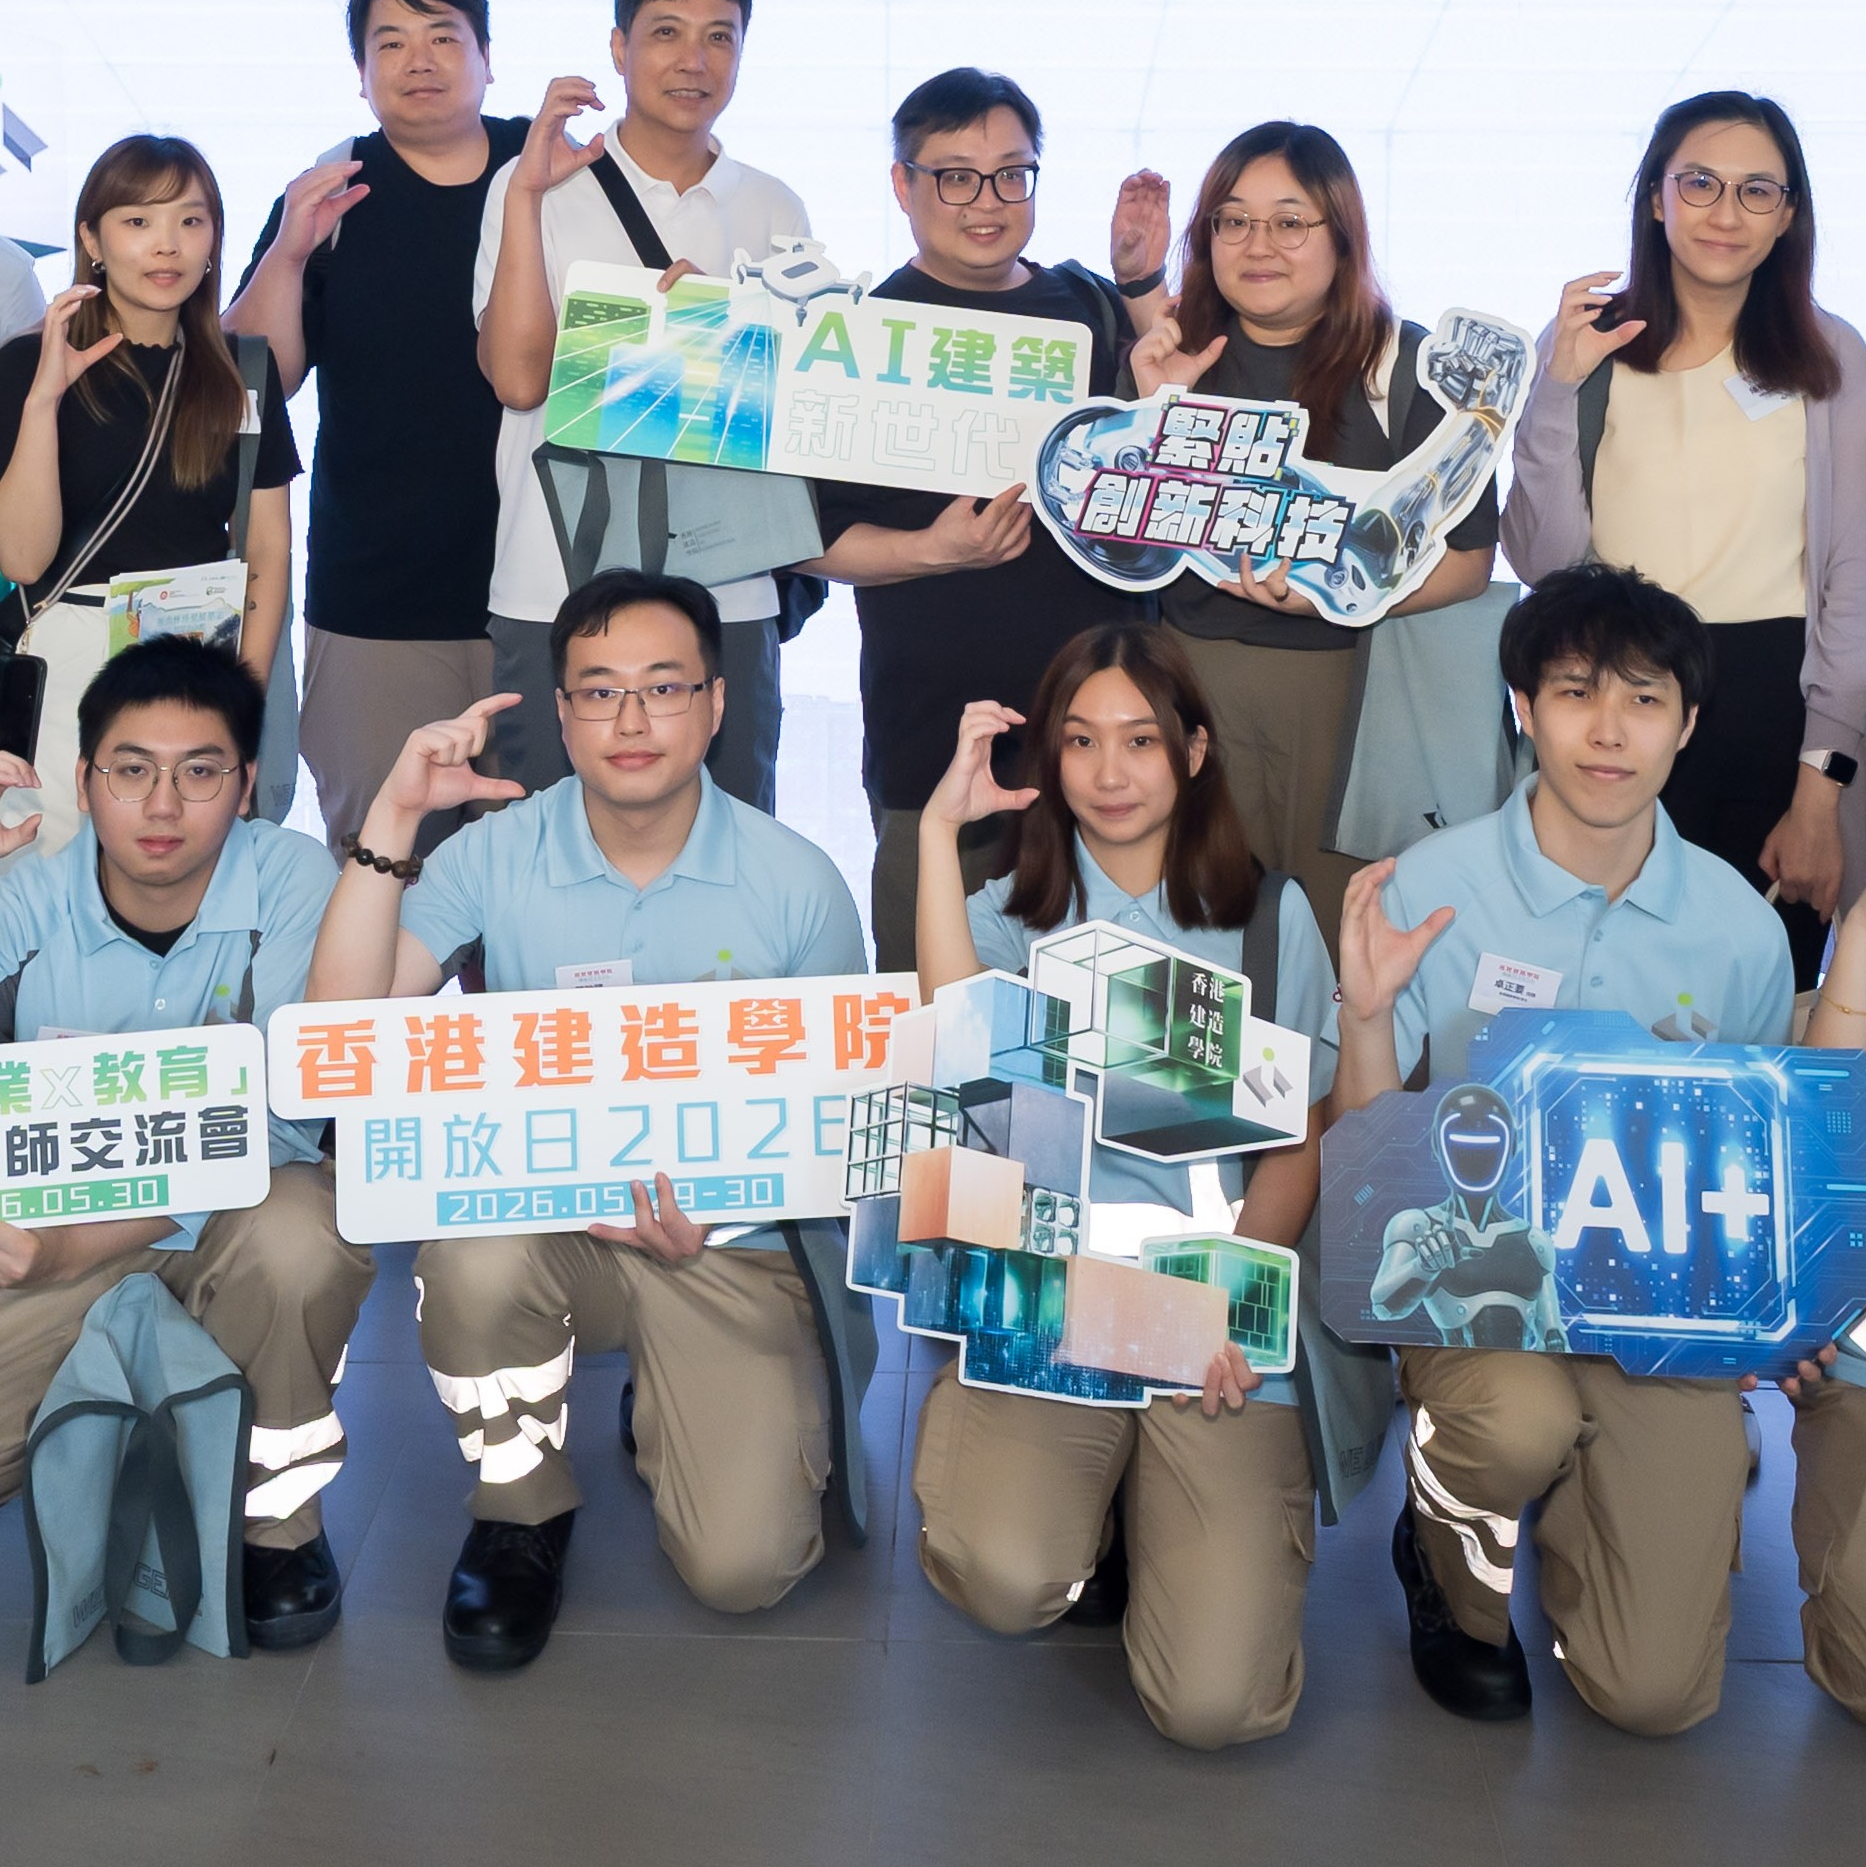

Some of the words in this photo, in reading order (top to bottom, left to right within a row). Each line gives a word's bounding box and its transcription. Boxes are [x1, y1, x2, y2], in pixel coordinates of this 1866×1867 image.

[794, 311, 1077, 405] AI建築
[784, 388, 1021, 481] 新世代
[1153, 405, 1291, 478] 緊貼
[1080, 472, 1350, 565] 創新科技
[1553, 1137, 1771, 1255] AI+
